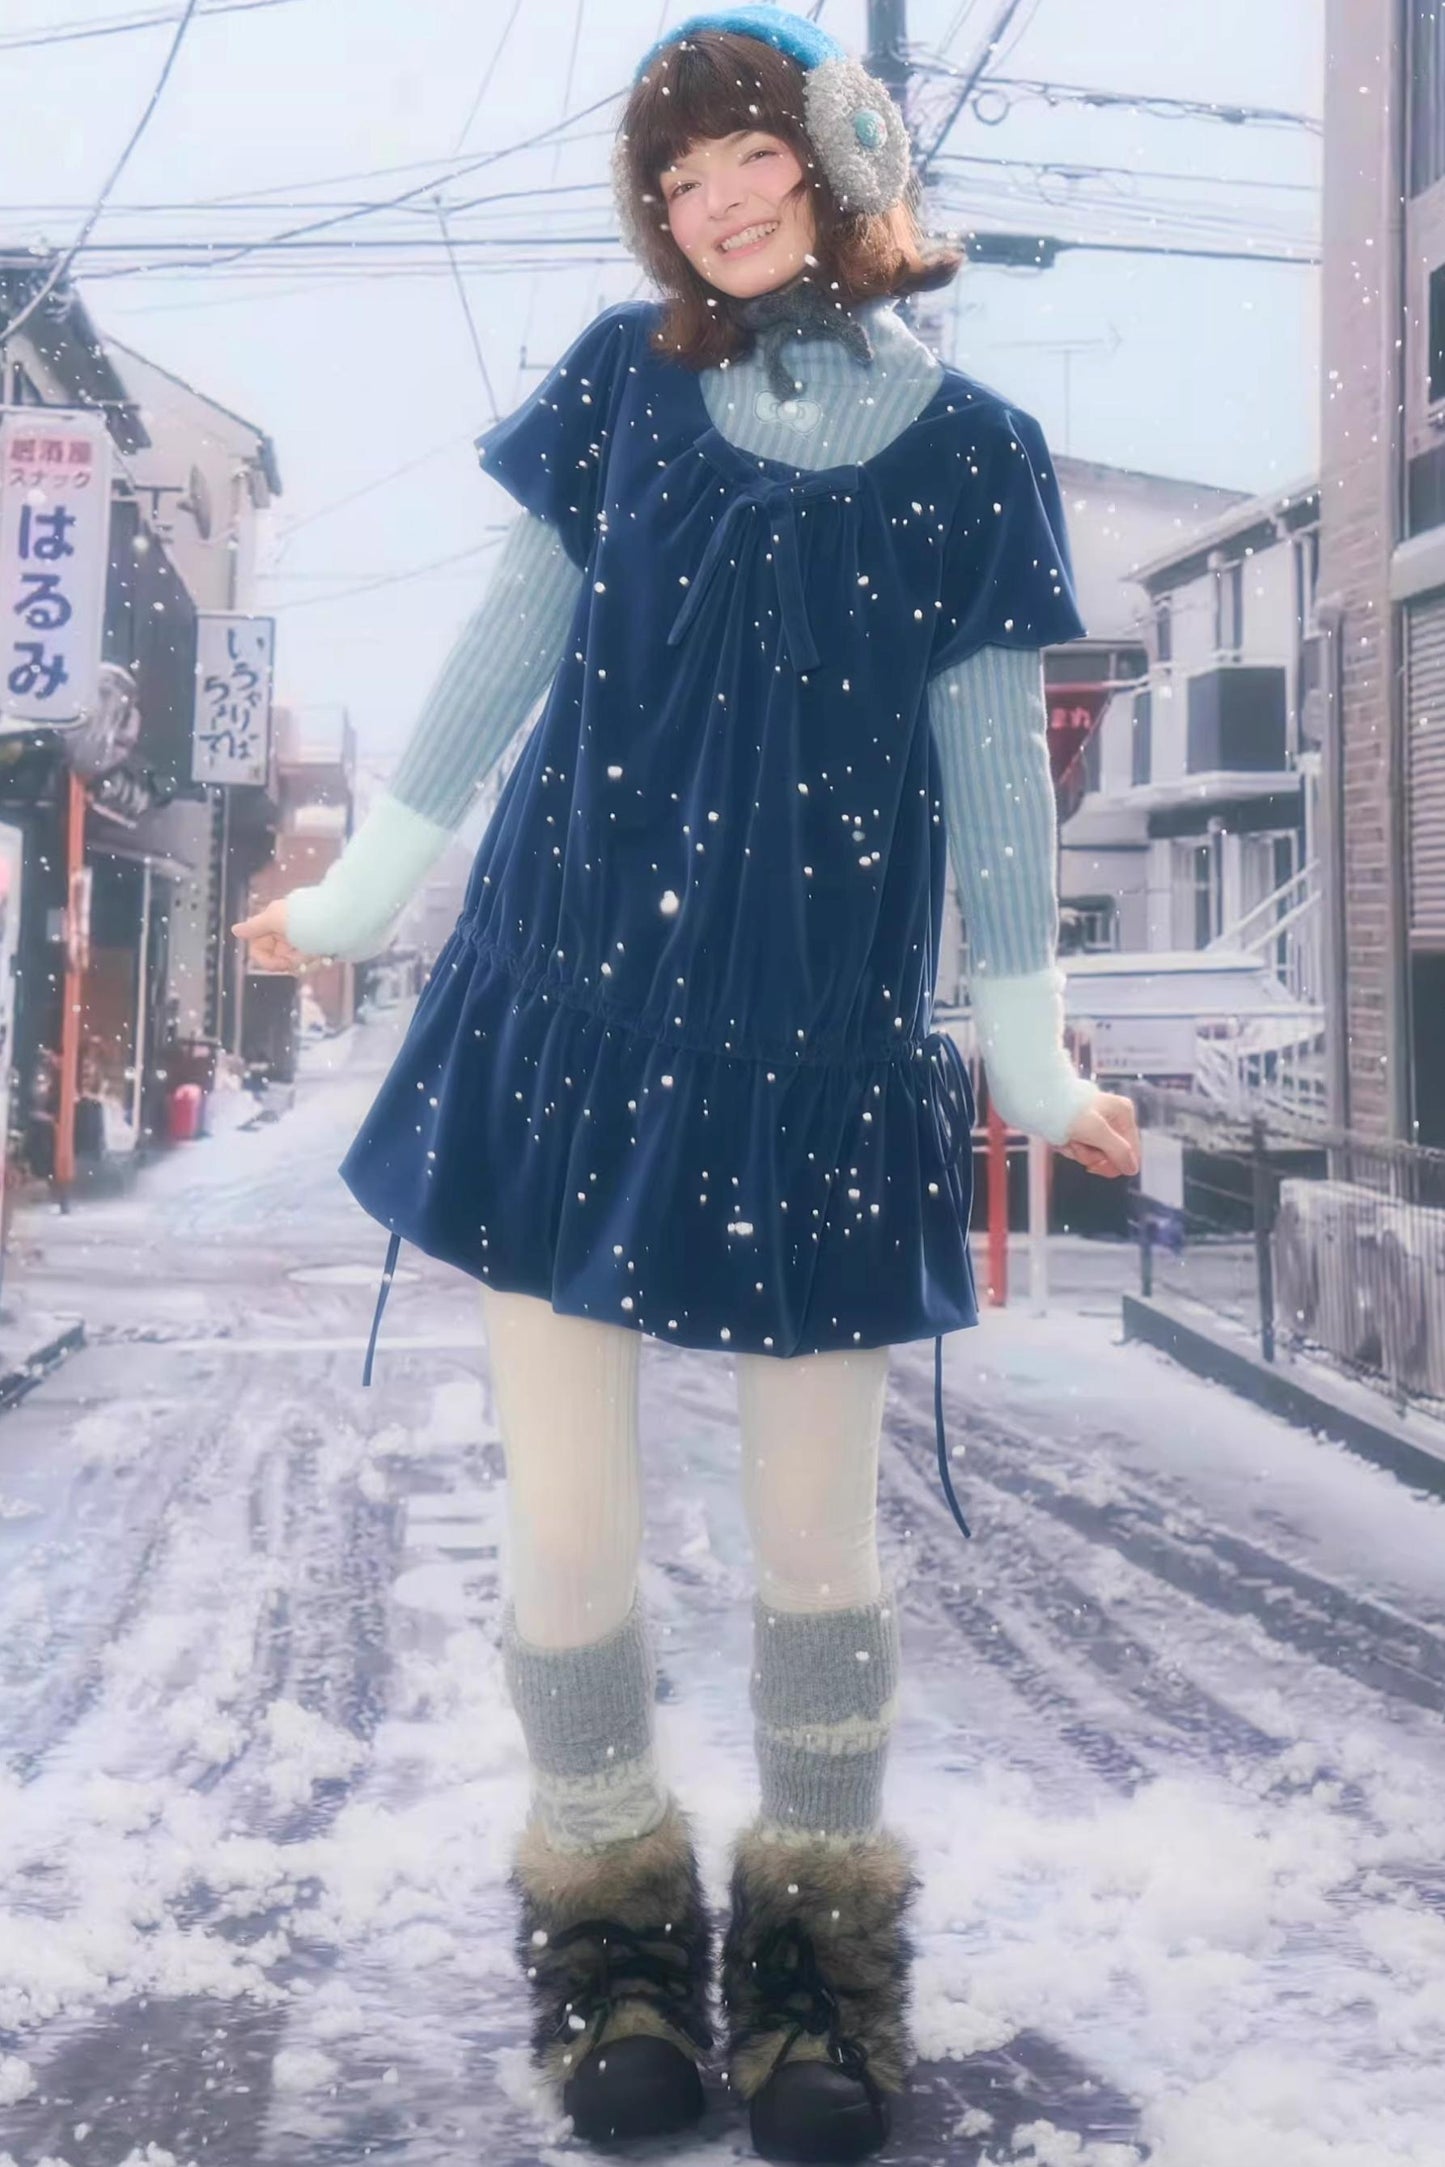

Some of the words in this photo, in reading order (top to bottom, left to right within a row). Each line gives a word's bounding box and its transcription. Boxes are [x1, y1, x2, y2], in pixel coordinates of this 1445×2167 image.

[10, 439, 91, 463] 居酒屋
[9, 468, 91, 490] スナック
[8, 505, 76, 700] はるみ
